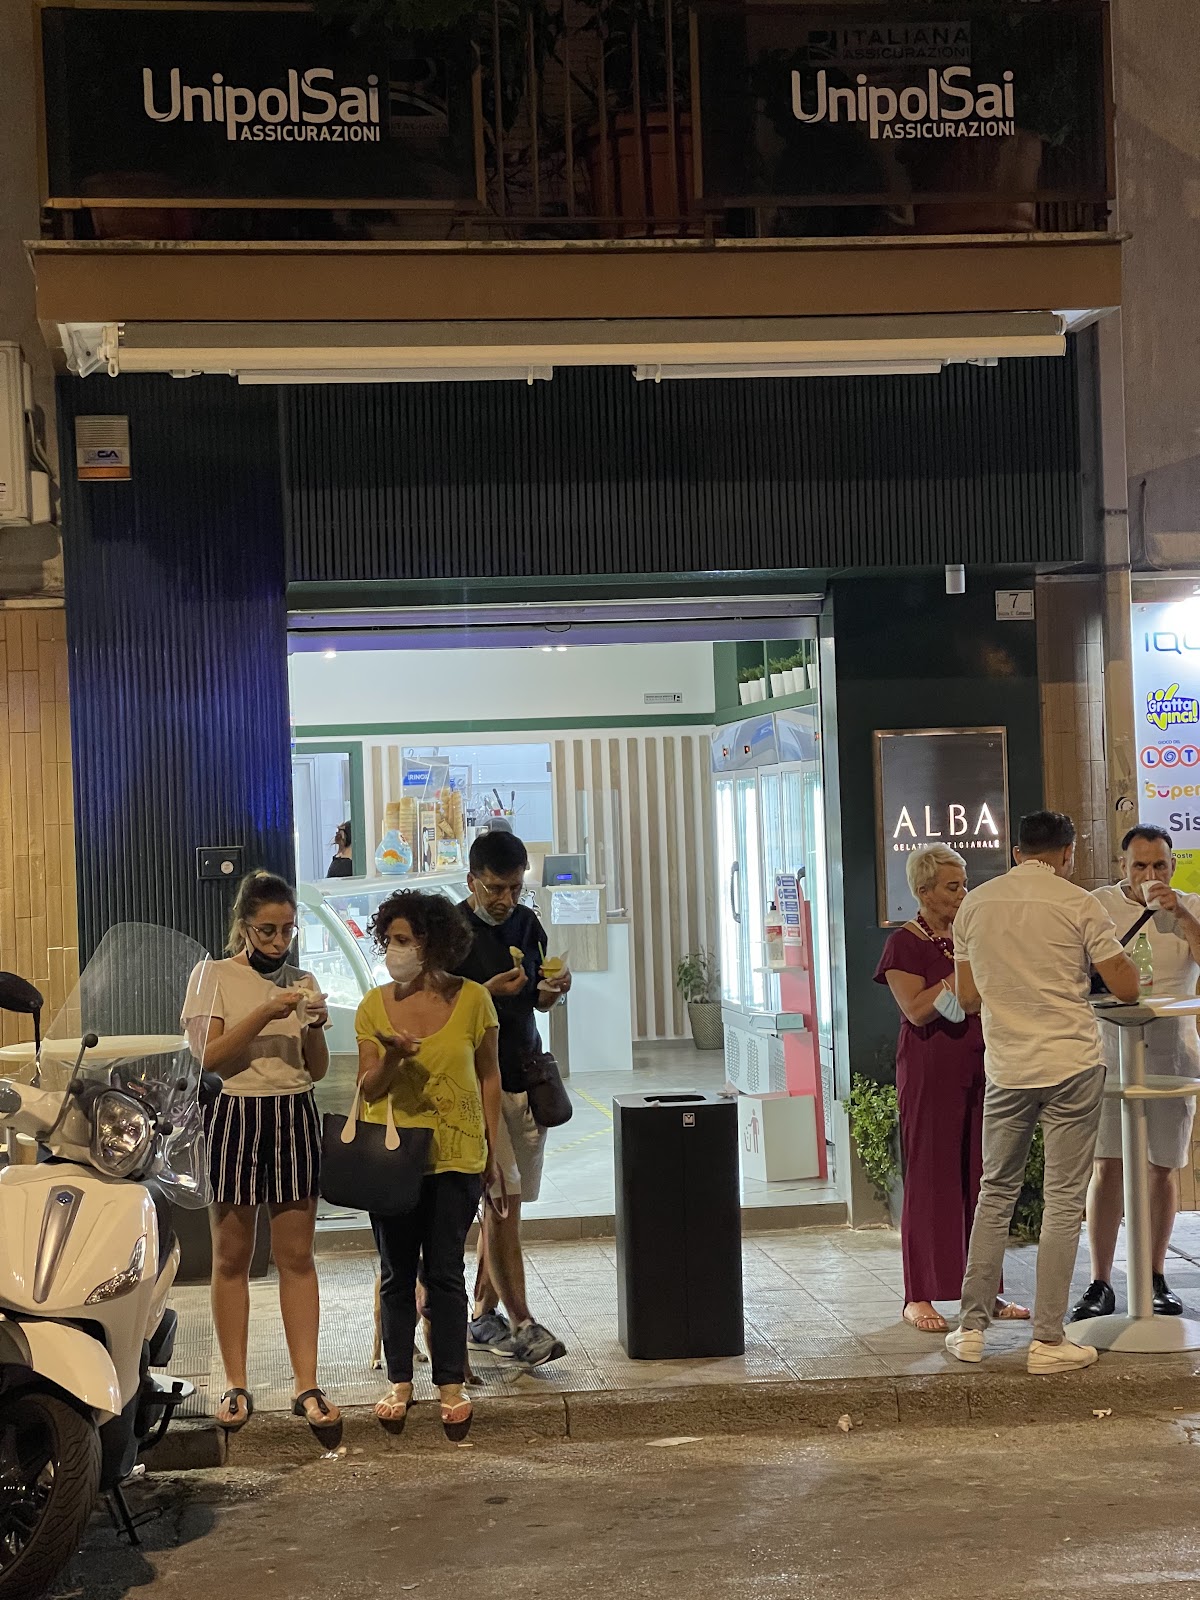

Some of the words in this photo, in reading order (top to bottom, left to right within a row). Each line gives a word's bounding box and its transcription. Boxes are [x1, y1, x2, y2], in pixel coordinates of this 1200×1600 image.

[843, 29, 969, 46] ITALIANA
[843, 47, 969, 60] ASSICURAZIONI
[143, 67, 380, 141] UnipolSai
[792, 66, 1014, 139] UnipolSai
[240, 124, 381, 142] ASSICURAZIONI
[882, 120, 1015, 139] ASSICURAZIONI
[1009, 593, 1019, 609] 7
[1148, 698, 1192, 713] Gratta
[1145, 783, 1200, 800] Super
[893, 802, 999, 838] ALBA
[944, 839, 1000, 849] TIGIANALE
